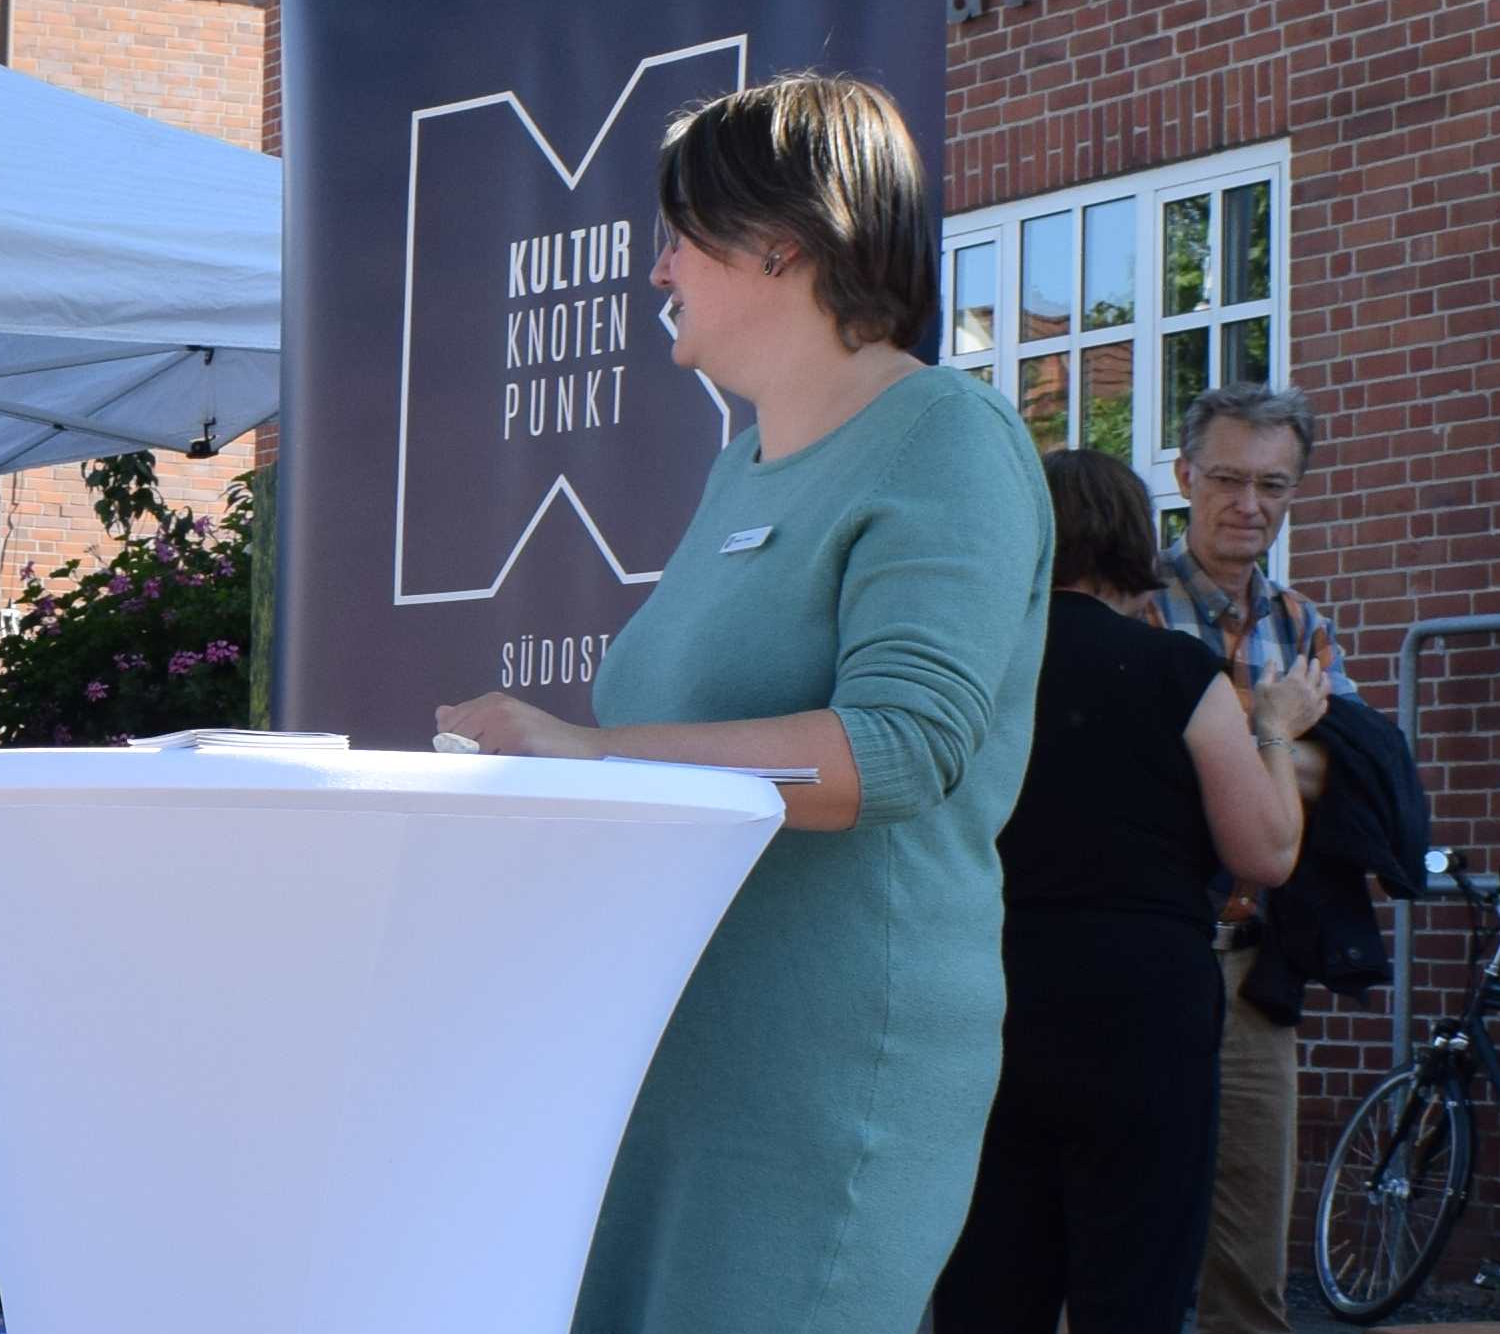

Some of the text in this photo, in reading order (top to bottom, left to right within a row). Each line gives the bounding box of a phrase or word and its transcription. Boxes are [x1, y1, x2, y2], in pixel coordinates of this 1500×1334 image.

[507, 219, 632, 299] KULTUR
[505, 292, 629, 369] KNOTEN
[503, 366, 626, 441] PUNKT
